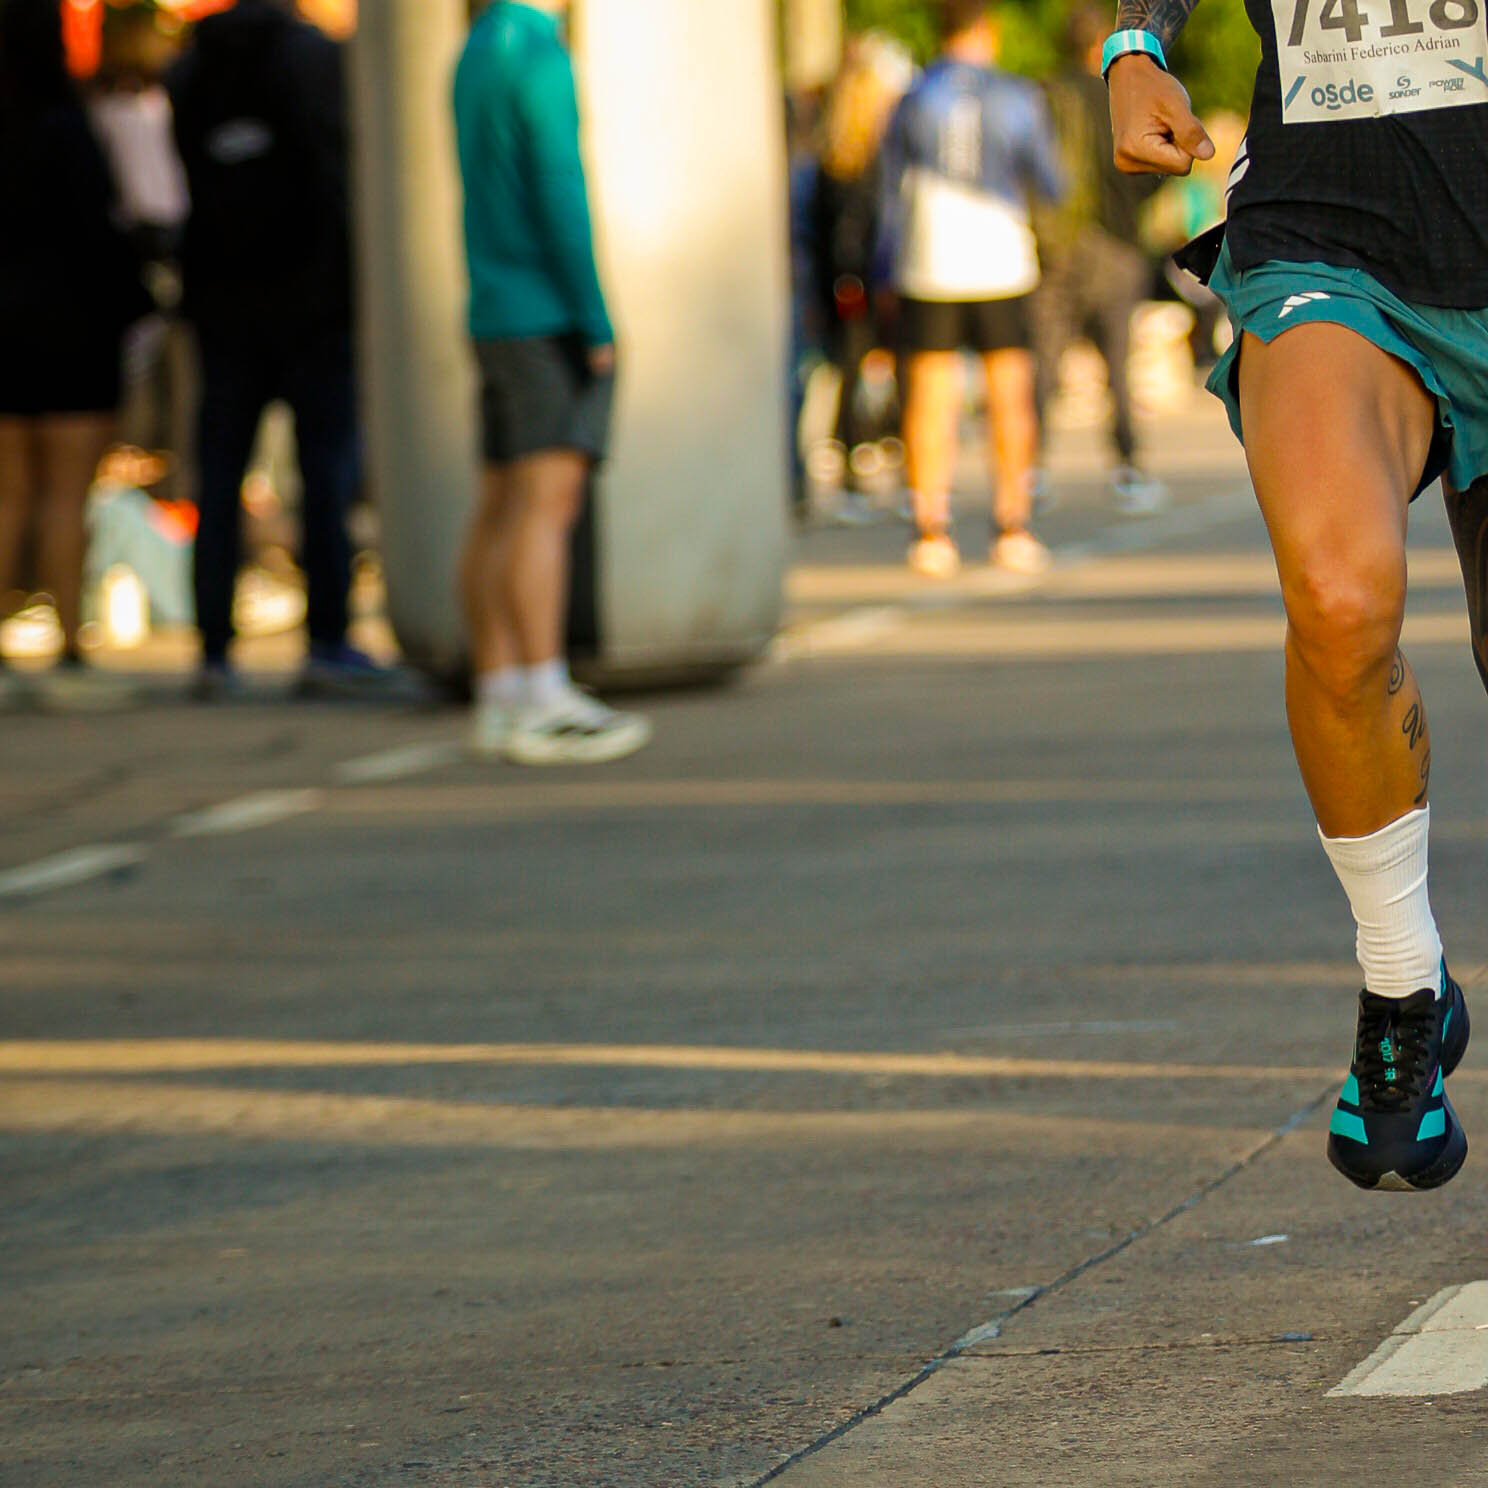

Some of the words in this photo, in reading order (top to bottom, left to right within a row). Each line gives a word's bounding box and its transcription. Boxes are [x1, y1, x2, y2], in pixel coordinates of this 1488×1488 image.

[1303, 49, 1348, 65] Sabarini
[1351, 42, 1411, 61] Federico
[1414, 35, 1461, 53] Adrian
[1311, 78, 1374, 110] osde
